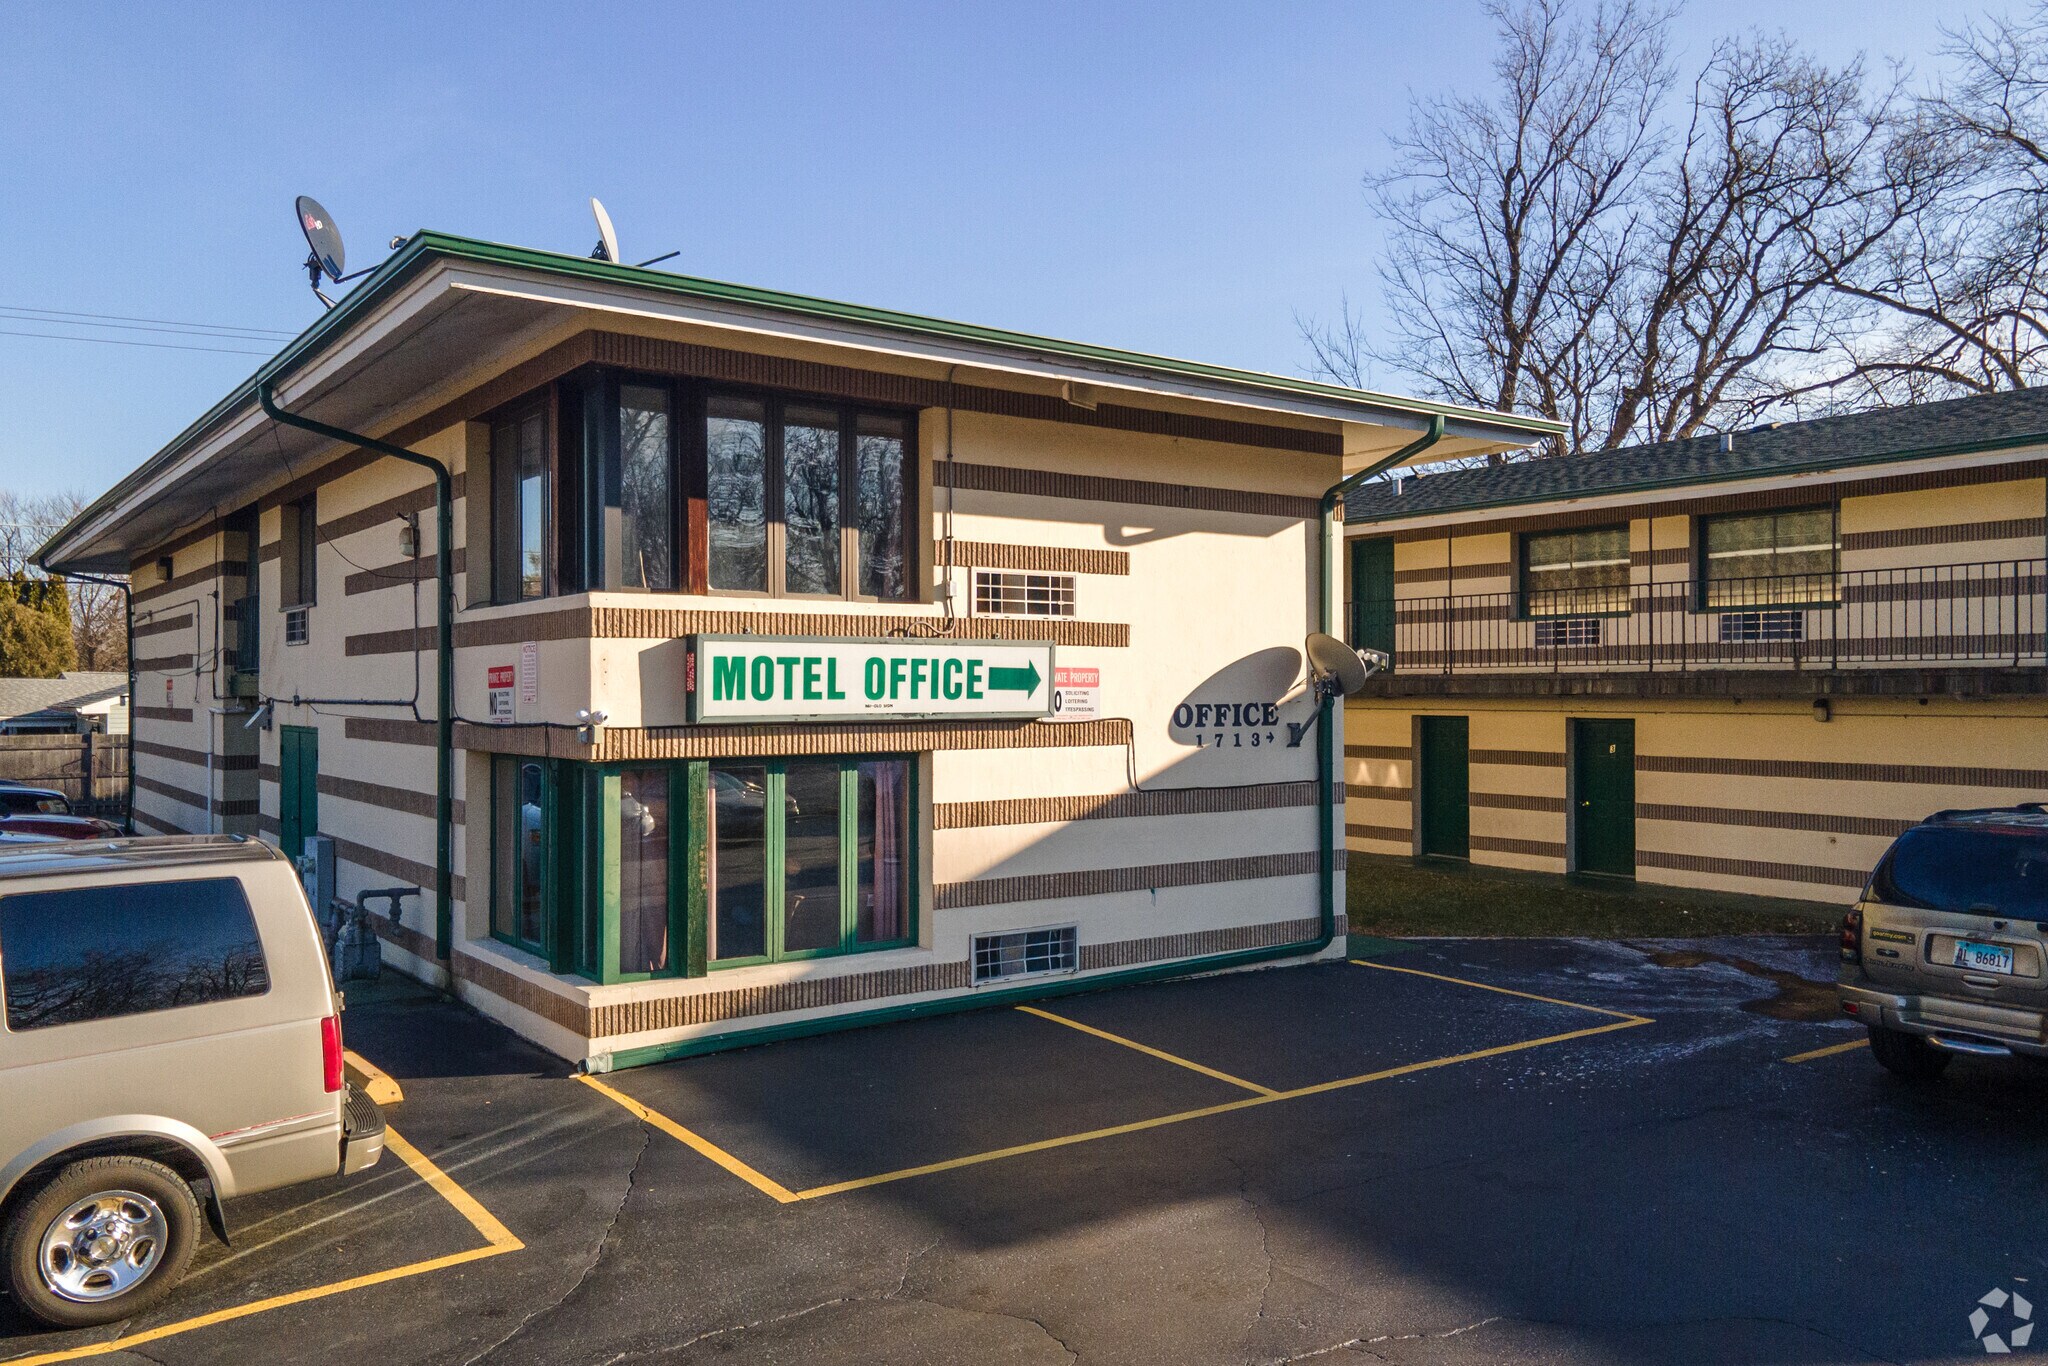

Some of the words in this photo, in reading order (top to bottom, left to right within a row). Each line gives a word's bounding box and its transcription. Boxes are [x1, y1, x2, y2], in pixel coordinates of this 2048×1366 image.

[712, 656, 846, 701] MOTEL
[864, 657, 984, 701] OFFICE
[1070, 671, 1098, 684] PROPERTY
[489, 692, 498, 716] NO
[1055, 690, 1062, 712] O
[1173, 702, 1279, 728] OFFICE
[1975, 951, 2010, 969] 86817
